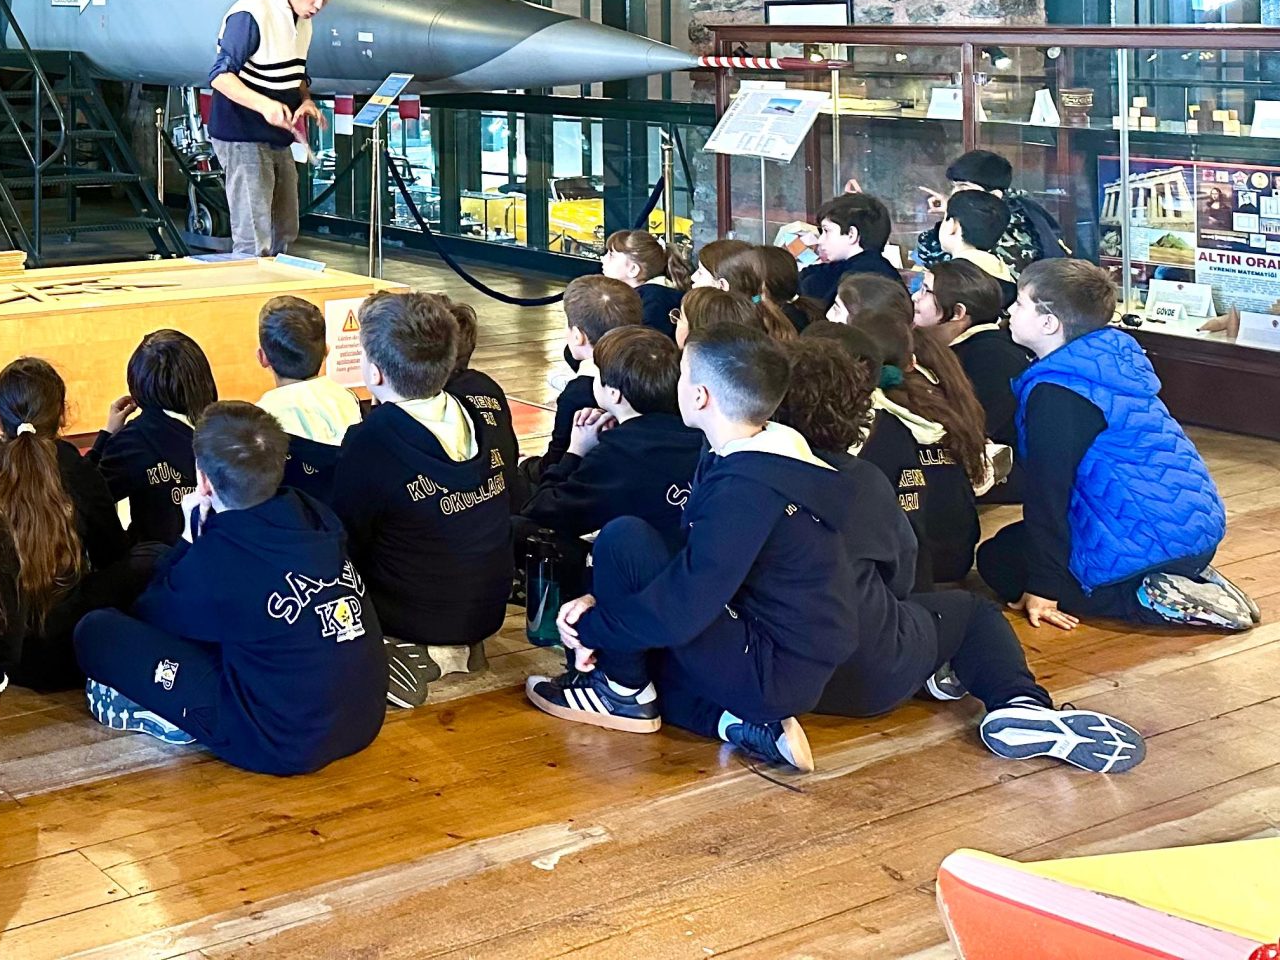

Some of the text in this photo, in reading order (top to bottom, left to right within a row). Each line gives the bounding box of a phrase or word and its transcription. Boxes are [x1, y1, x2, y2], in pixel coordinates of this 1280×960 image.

[1198, 251, 1241, 266] ALTIN
[1209, 265, 1278, 279] EVRENİN MATEMATİĞİ
[1156, 307, 1176, 317] GÖVDE
